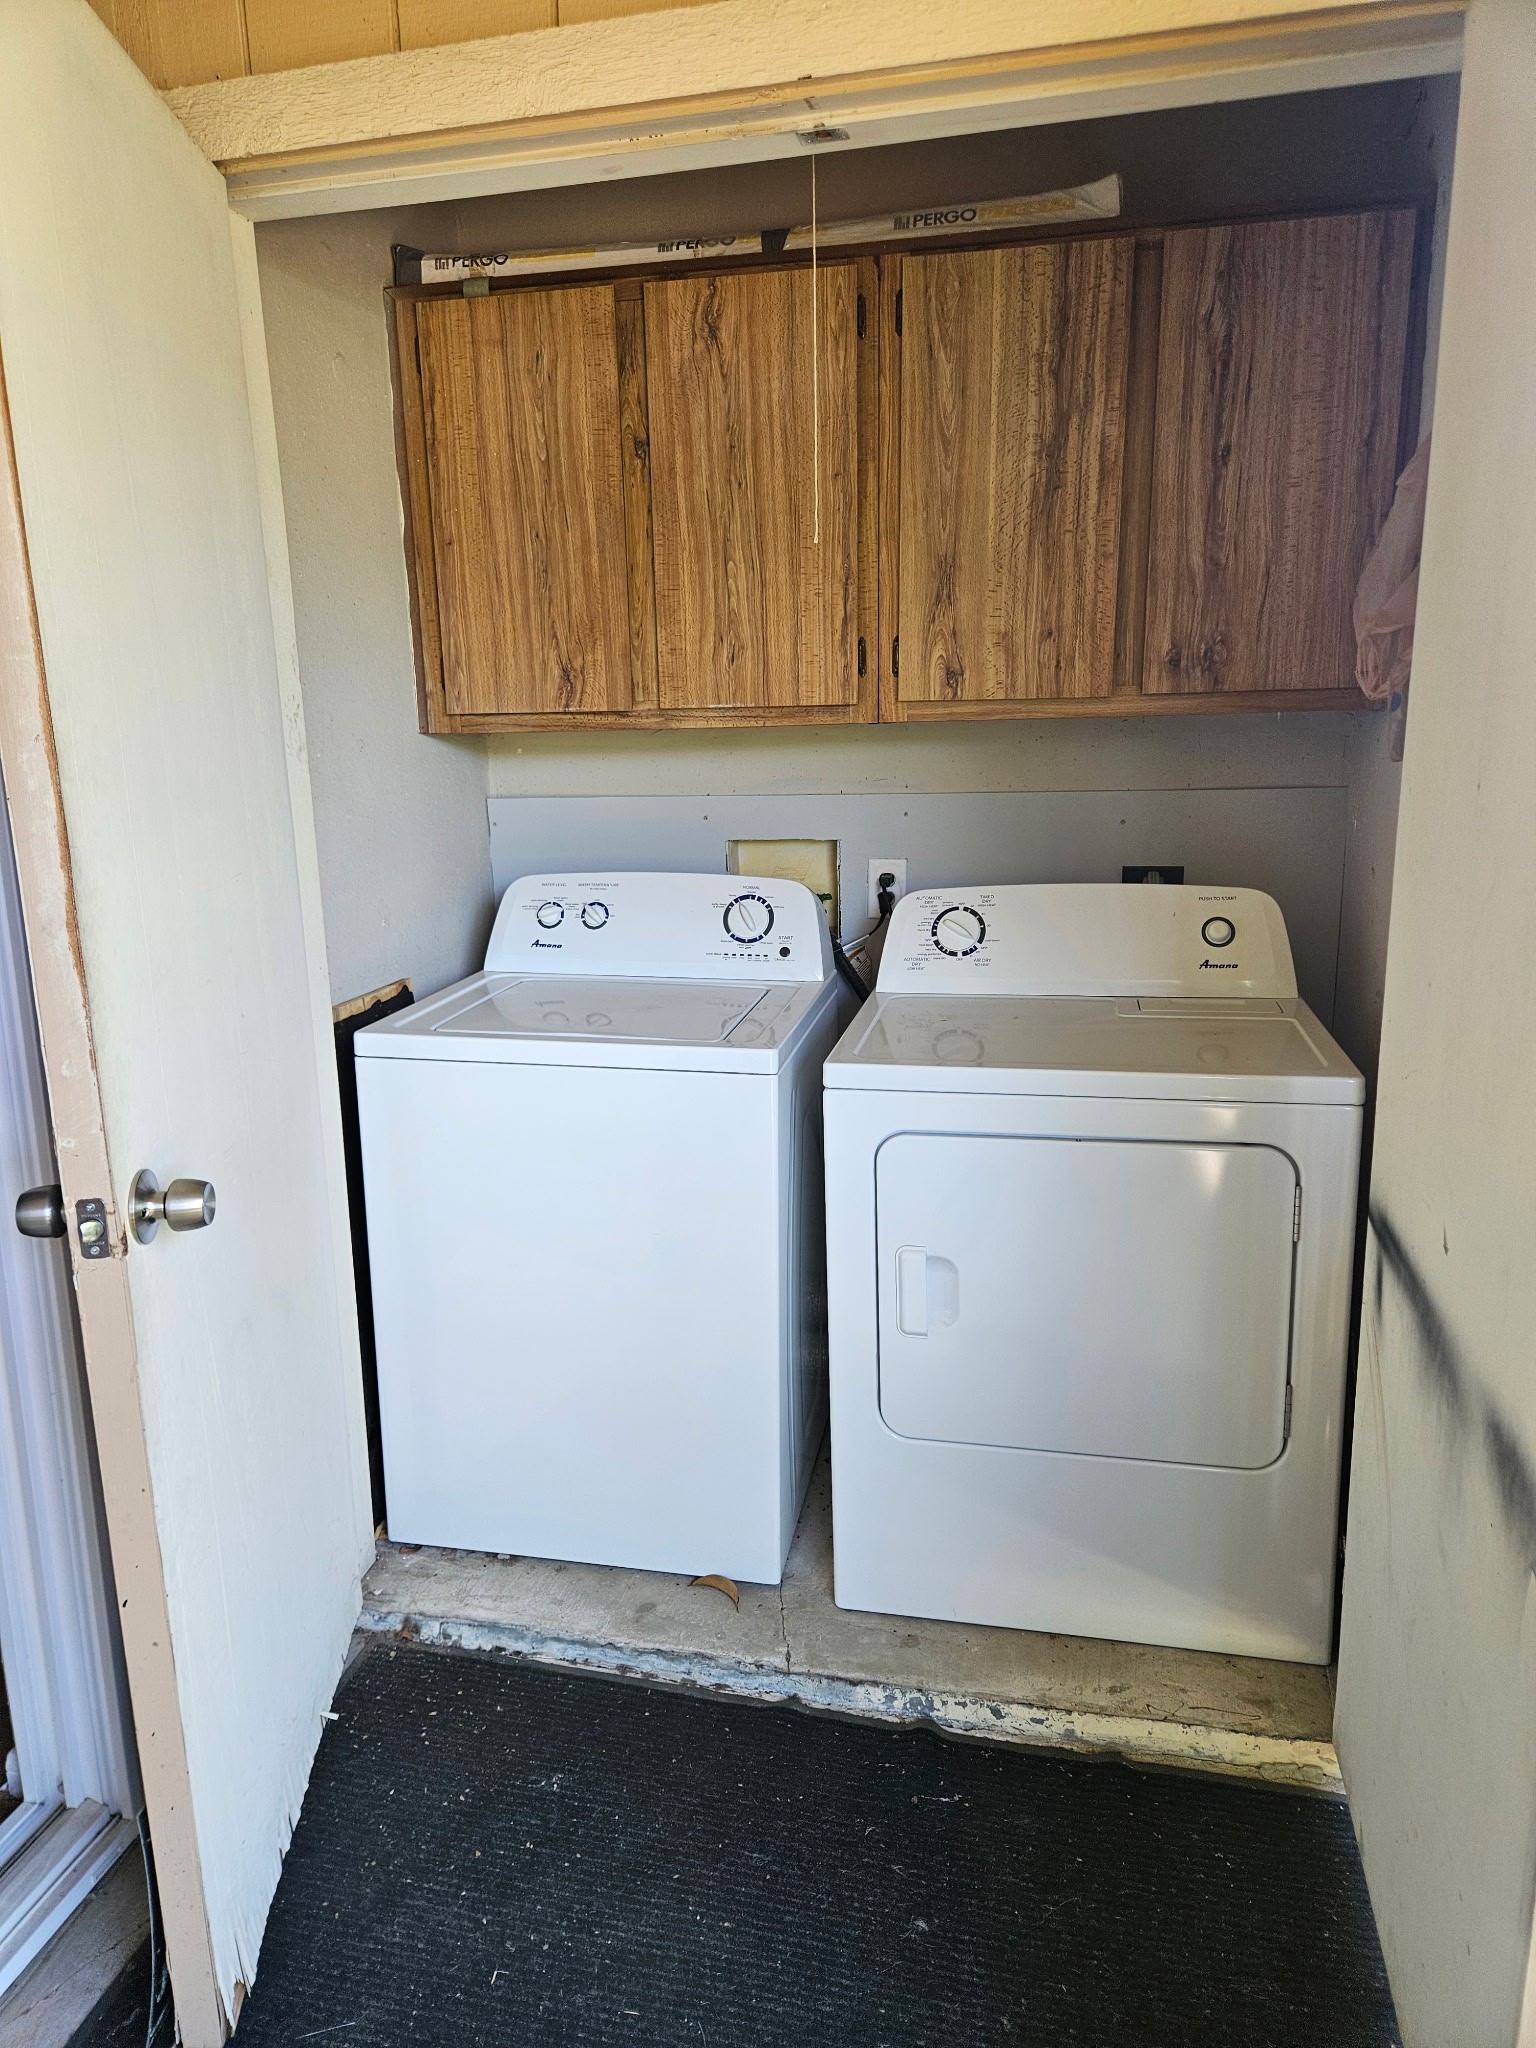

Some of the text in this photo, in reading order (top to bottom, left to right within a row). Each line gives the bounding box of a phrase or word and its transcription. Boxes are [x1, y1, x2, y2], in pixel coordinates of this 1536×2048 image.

[913, 208, 977, 228] PERGO
[452, 254, 509, 268] PERGO
[531, 939, 562, 949] Amana
[1199, 959, 1239, 970] Amana
